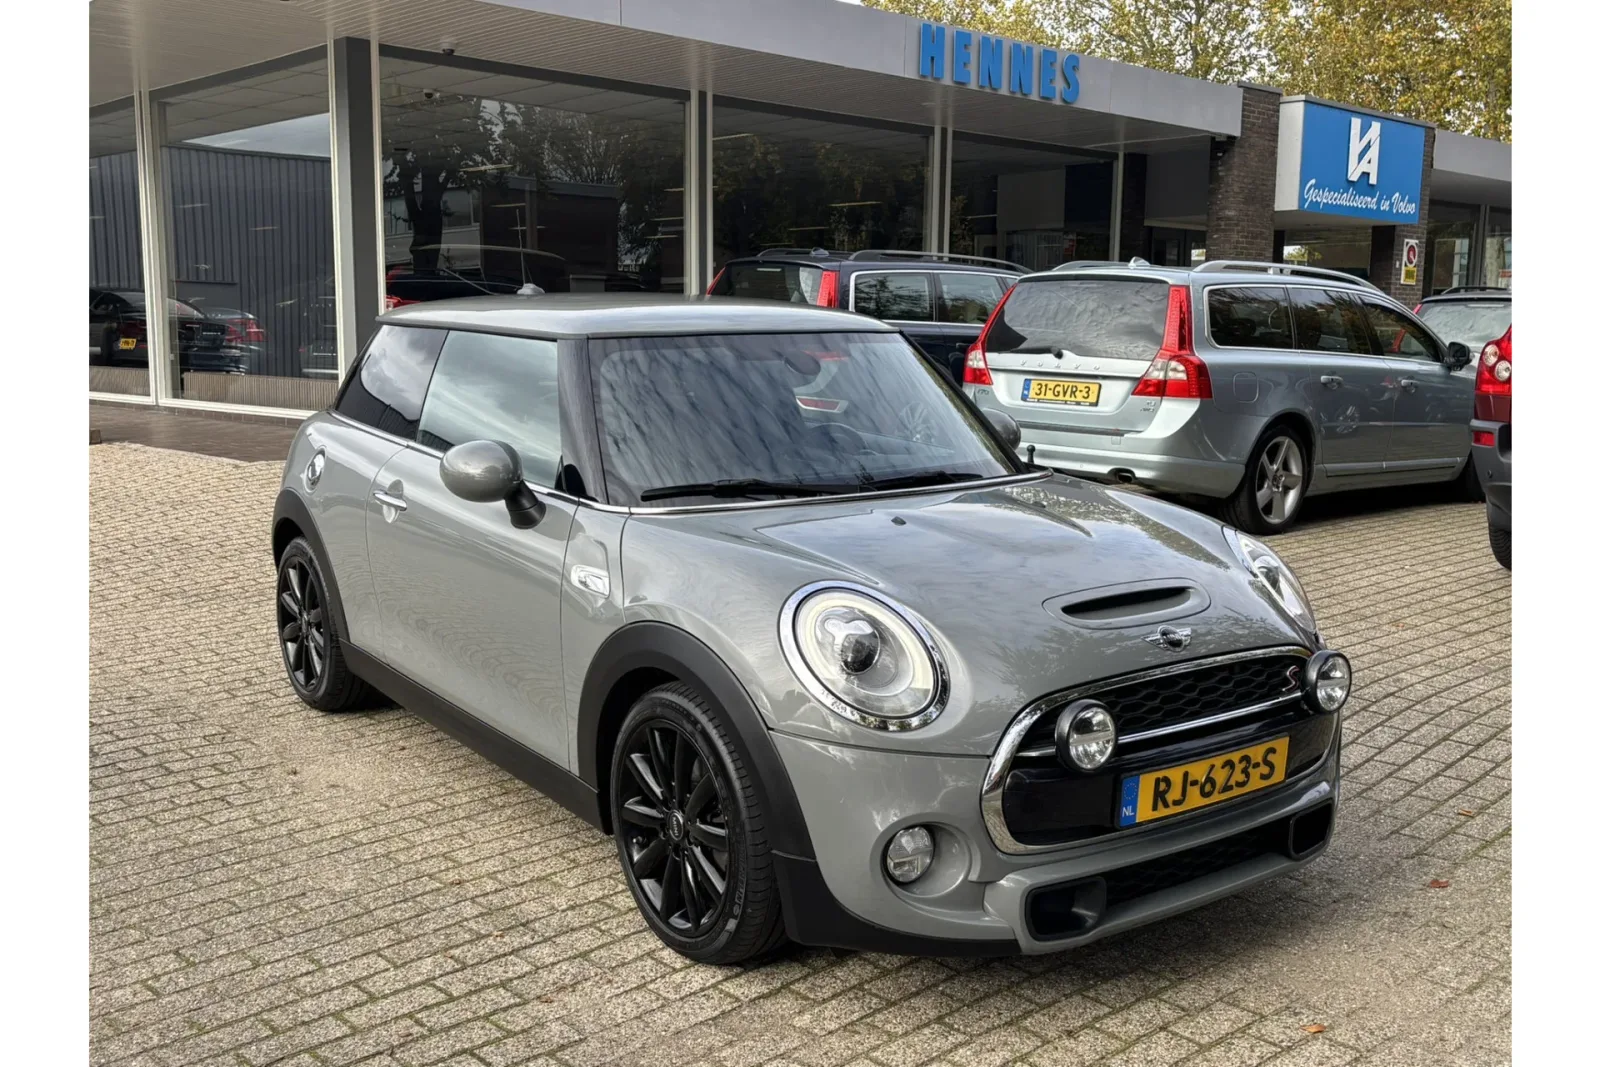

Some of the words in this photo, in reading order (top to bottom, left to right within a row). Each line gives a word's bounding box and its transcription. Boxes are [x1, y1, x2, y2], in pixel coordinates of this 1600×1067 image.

[919, 22, 1080, 104] HENNES
[1303, 178, 1379, 209] Gespecialiseerd
[1380, 195, 1390, 211] in
[1391, 191, 1416, 215] Volvo
[1034, 382, 1091, 400] 31-GVR-3
[1151, 746, 1277, 812] RJ-623-S
[1121, 805, 1135, 818] NL
